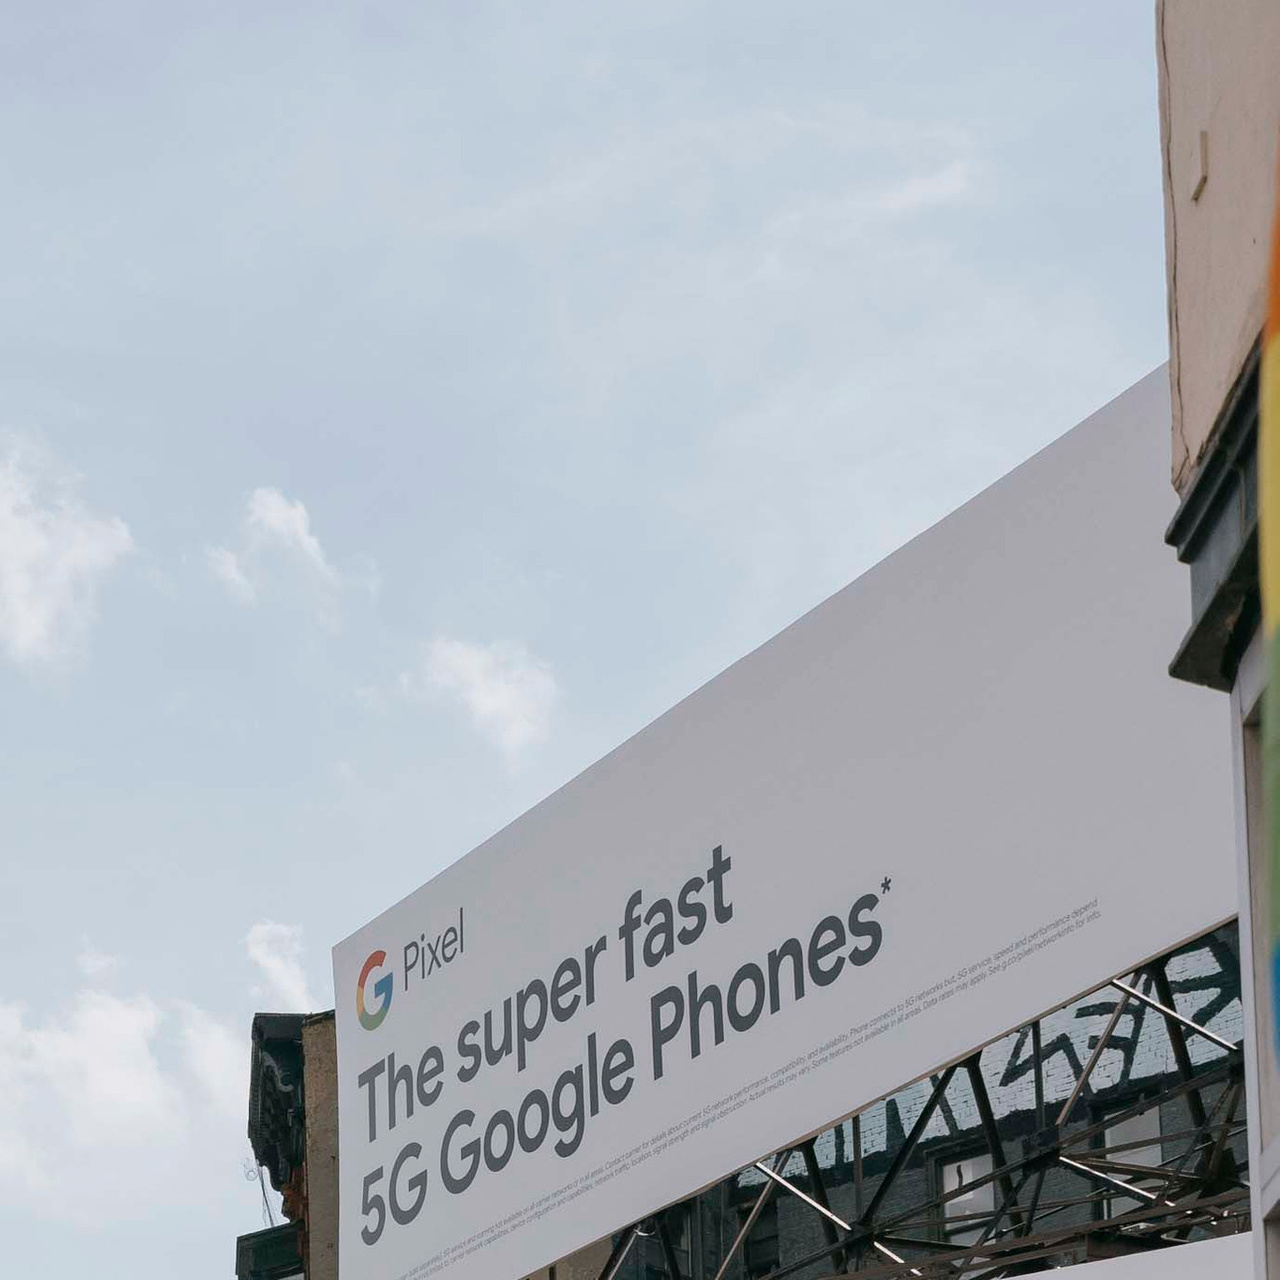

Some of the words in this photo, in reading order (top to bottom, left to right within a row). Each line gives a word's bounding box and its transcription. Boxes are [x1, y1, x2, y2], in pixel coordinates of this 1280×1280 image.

[358, 1048, 444, 1143] The
[456, 939, 607, 1084] super
[619, 844, 734, 982] fast
[403, 908, 465, 992] Pixel
[850, 1021, 869, 1037] Phone
[915, 981, 942, 1002] networks
[1028, 913, 1070, 942] performance
[1071, 898, 1097, 918] depend
[923, 997, 938, 1010] Data
[360, 1140, 427, 1247] 5G
[440, 1026, 634, 1195] Google
